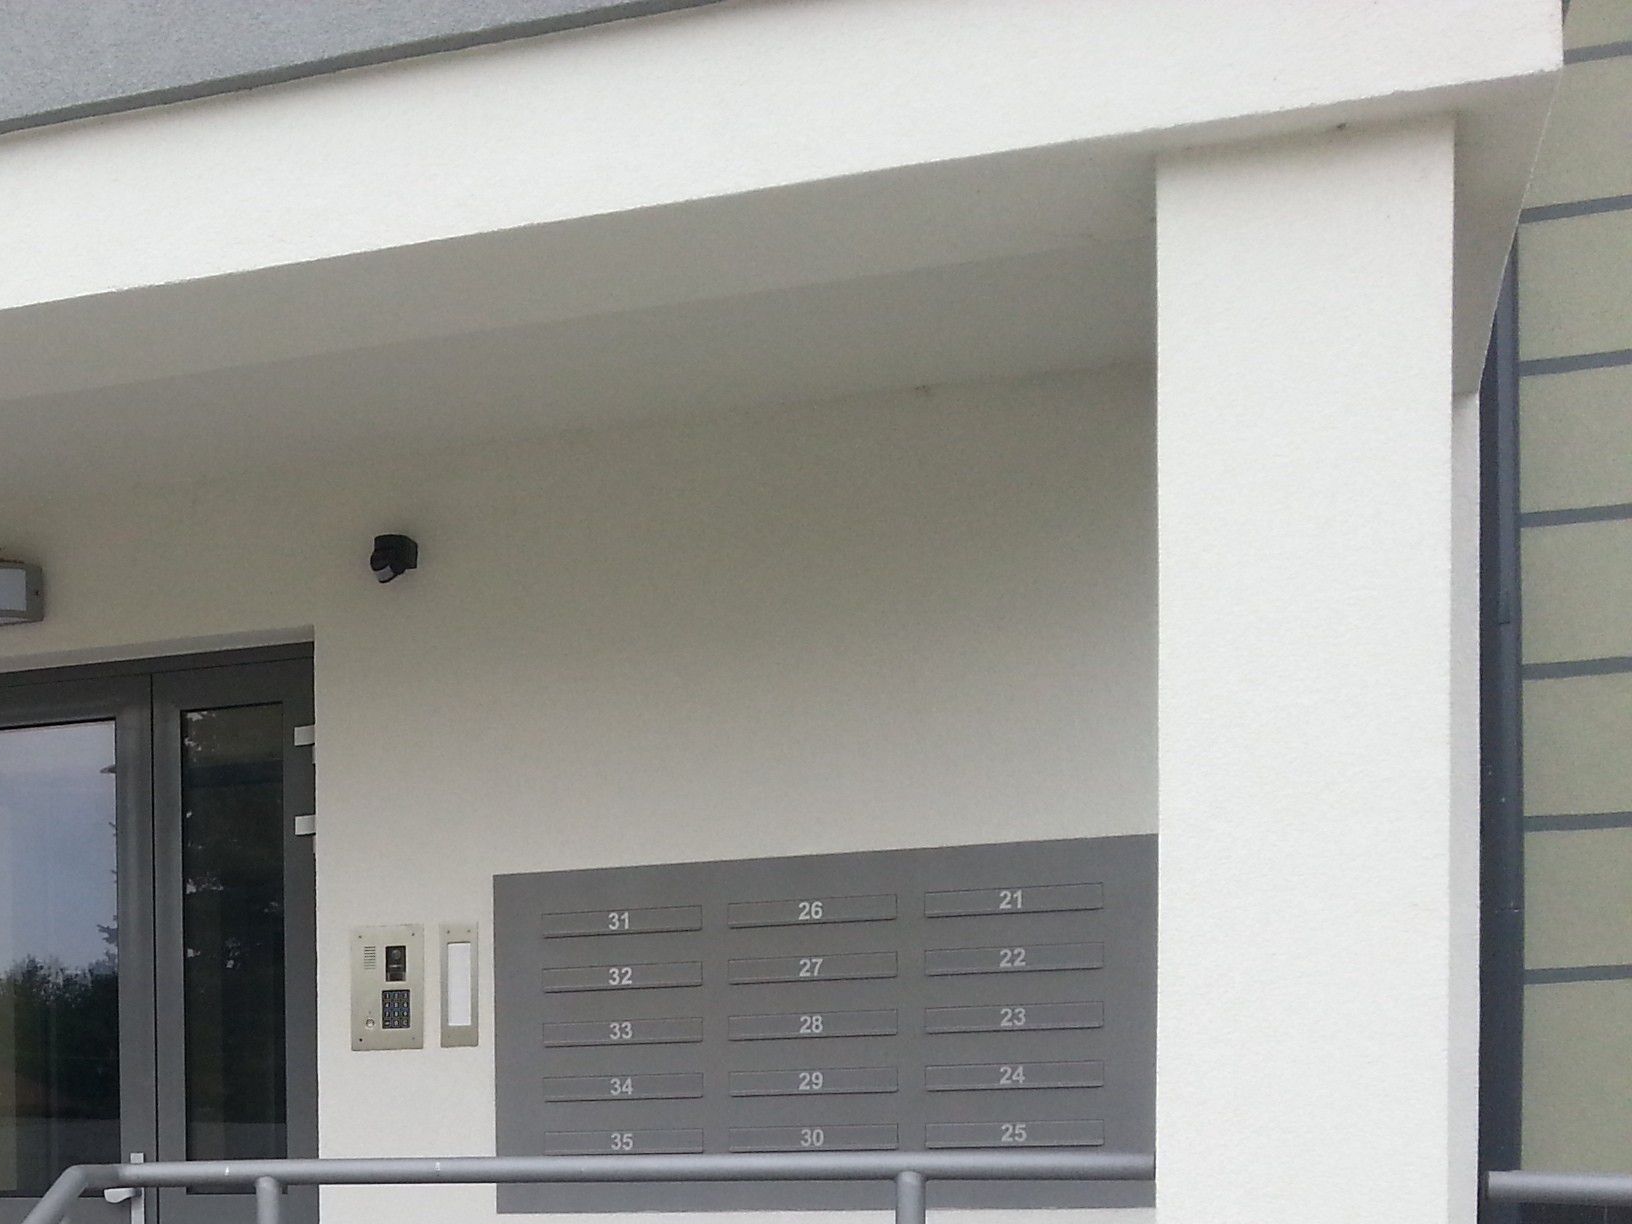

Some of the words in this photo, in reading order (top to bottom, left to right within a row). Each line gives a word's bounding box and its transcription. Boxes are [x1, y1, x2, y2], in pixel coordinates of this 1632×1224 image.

[999, 889, 1023, 910] 21
[608, 911, 631, 931] 31
[798, 900, 823, 921] 26
[798, 957, 824, 977] 27
[999, 947, 1026, 968] 22
[608, 966, 633, 986] 32
[799, 1014, 824, 1034] 28
[1000, 1007, 1026, 1028] 23
[609, 1021, 633, 1042] 33
[798, 1071, 824, 1091] 29
[999, 1065, 1026, 1086] 24
[610, 1077, 634, 1096] 34
[610, 1132, 634, 1151] 35
[800, 1128, 824, 1150] 30
[1000, 1123, 1027, 1144] 25
